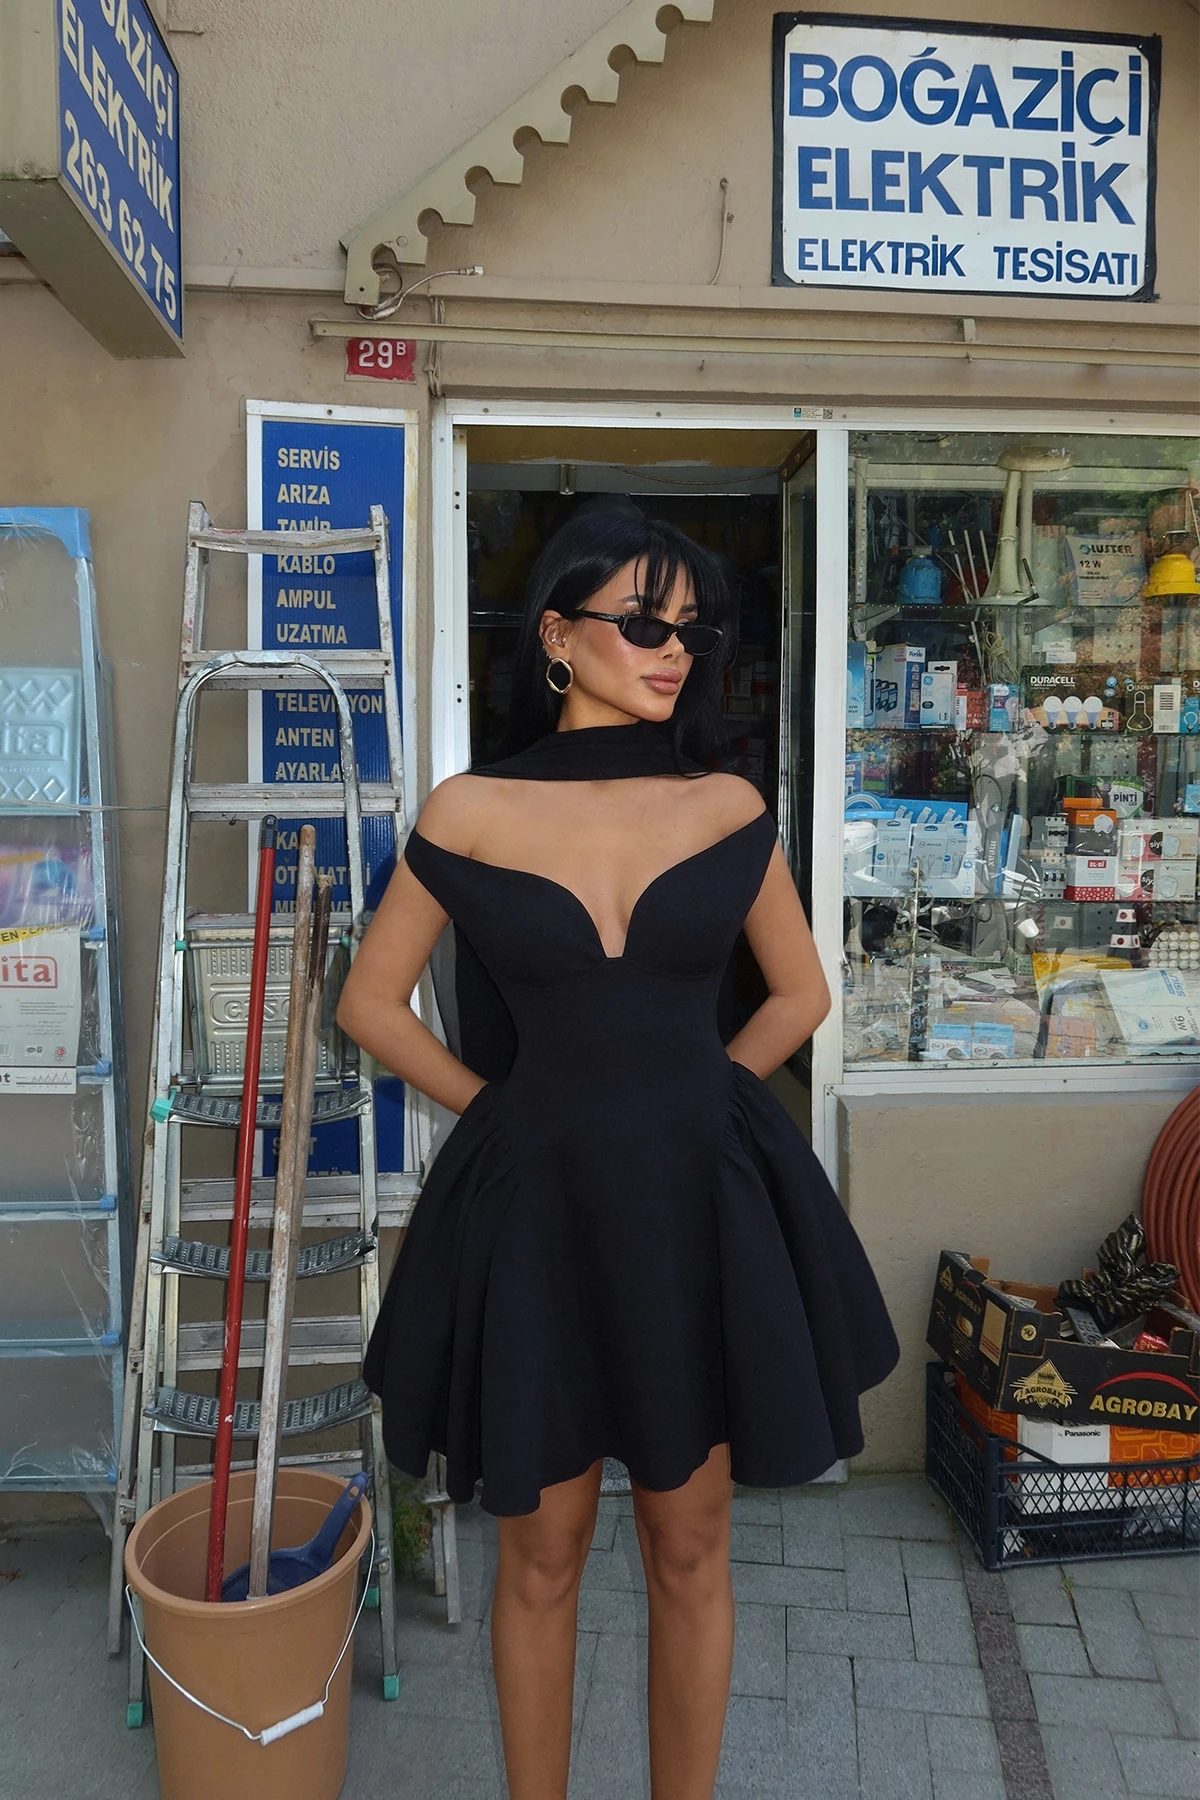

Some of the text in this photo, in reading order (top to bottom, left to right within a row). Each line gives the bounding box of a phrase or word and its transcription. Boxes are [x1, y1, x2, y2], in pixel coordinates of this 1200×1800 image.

[788, 46, 1142, 147] BOĞAZİÇİ
[61, 0, 174, 233] ELEKTRİK
[797, 141, 1136, 226] ELEKTRİK
[65, 109, 176, 321] 263 62 75
[798, 234, 1138, 287] ELEKTRİK TESİSATI
[277, 446, 341, 471] SERVİS
[277, 484, 331, 506] ARIZA
[277, 554, 336, 575] KABLO
[276, 588, 336, 609] AMPUL
[276, 624, 348, 645] UZATMA
[1030, 676, 1076, 684] DURACELL
[275, 727, 335, 748] ANTEN
[1024, 1386, 1063, 1398] AGROBAY
[1089, 1395, 1198, 1421] AGROBAY
[1064, 1429, 1101, 1437] Panasonic
